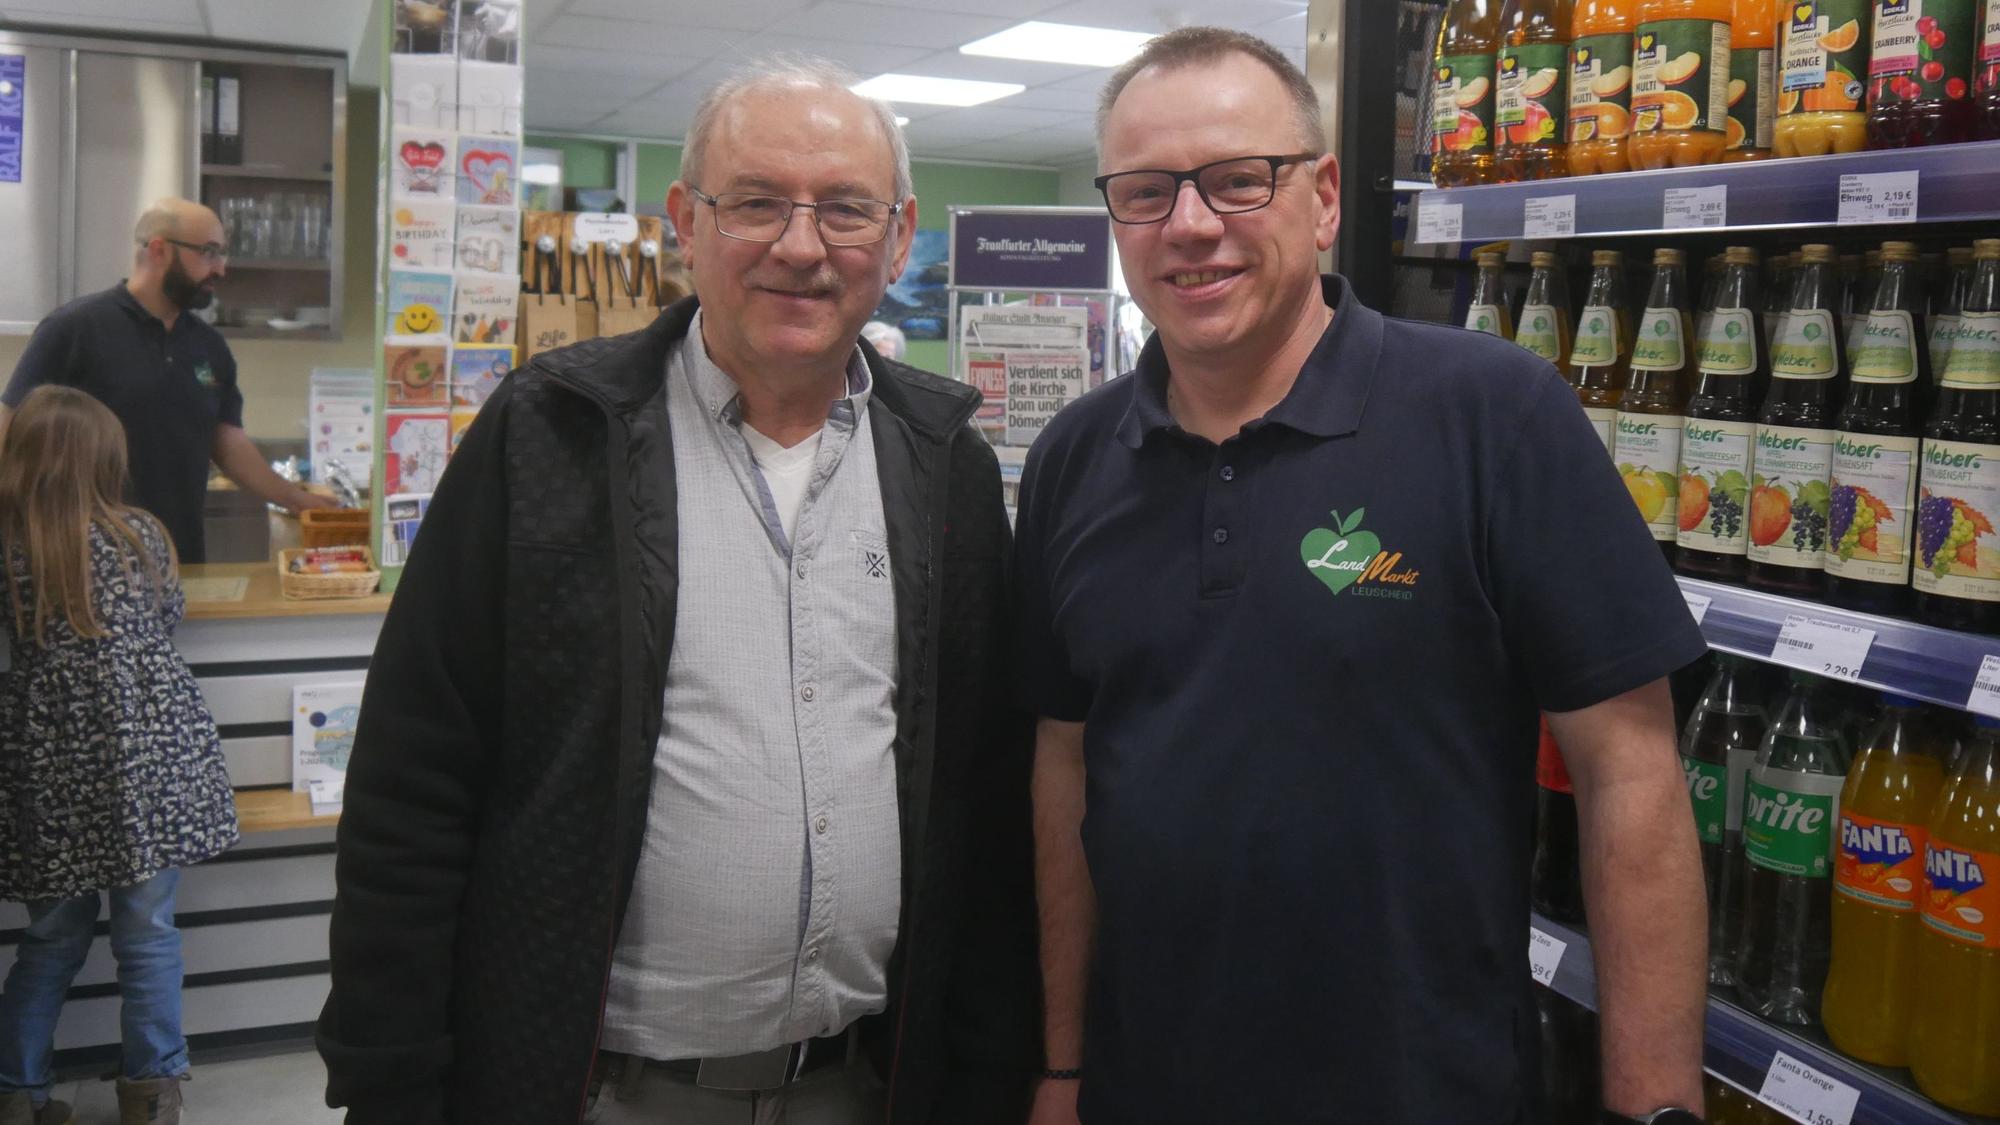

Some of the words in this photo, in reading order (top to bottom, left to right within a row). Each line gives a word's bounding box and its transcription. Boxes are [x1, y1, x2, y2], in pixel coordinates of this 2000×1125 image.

[1875, 35, 1916, 49] CRANBERRY
[1786, 55, 1820, 70] ORANGE
[1636, 80, 1656, 93] MULTI
[1573, 94, 1592, 105] MULTI
[1840, 193, 1873, 203] Einweg
[1884, 191, 1904, 201] 2,19
[1906, 190, 1912, 200] €
[396, 229, 447, 240] BIRTHDAY
[977, 236, 1031, 253] Frankfurter
[1032, 238, 1086, 255] Allgemeine
[1009, 366, 1058, 381] Verdient
[1061, 366, 1083, 380] sich
[1009, 382, 1026, 396] die
[1030, 382, 1067, 396] Kirche
[1009, 399, 1035, 412] Dom
[1038, 397, 1061, 412] und
[1307, 539, 1370, 572] Land
[1357, 550, 1420, 585] Markt
[1351, 586, 1412, 600] LEUSCHEID
[1851, 668, 1860, 678] €
[1841, 817, 1913, 856] FANTA
[1776, 1056, 1801, 1074] Fanta
[1802, 1069, 1835, 1092] Orange
